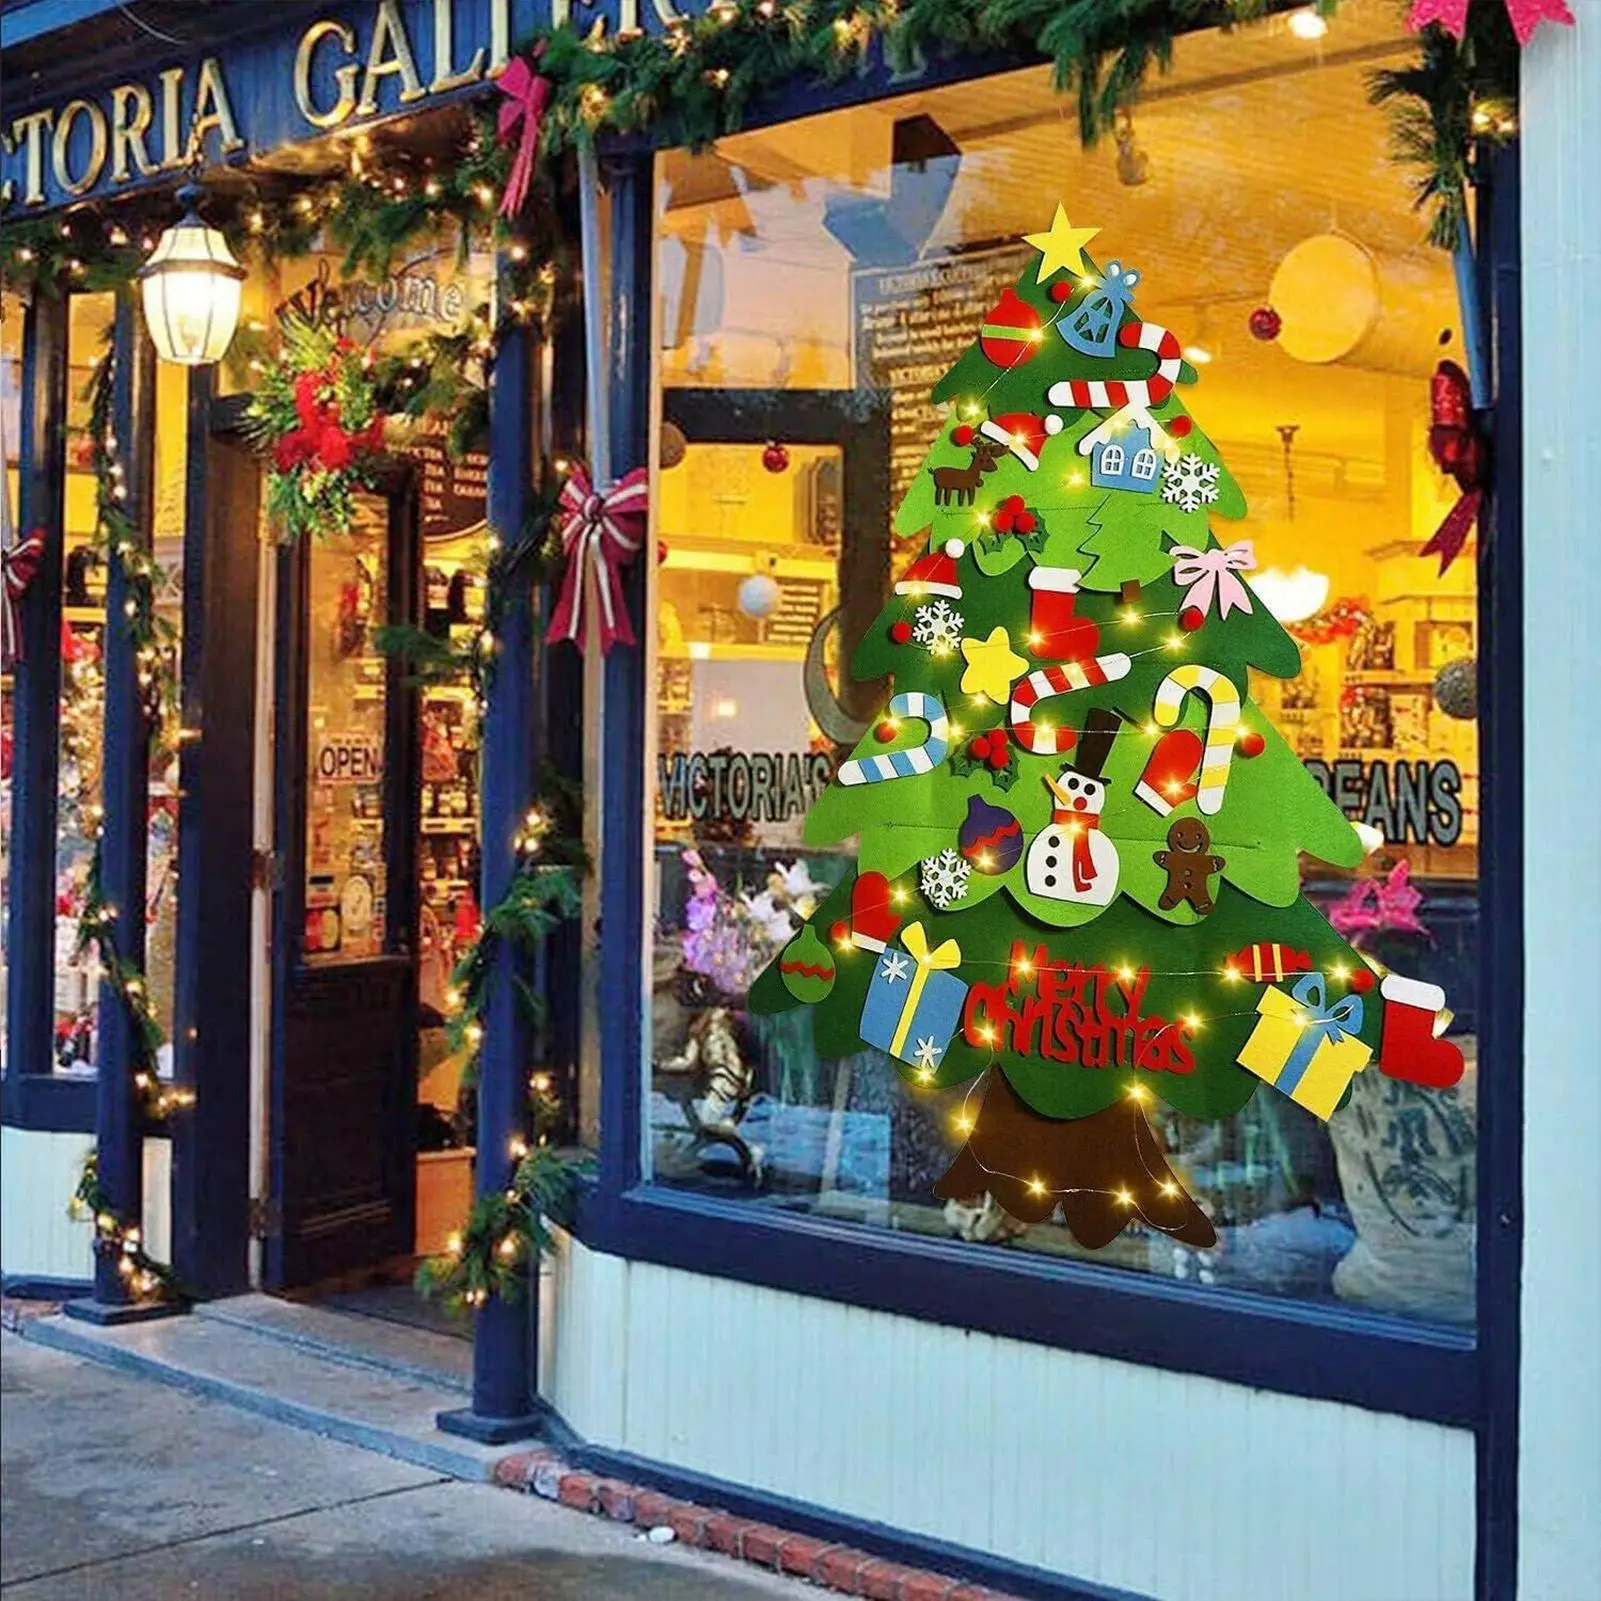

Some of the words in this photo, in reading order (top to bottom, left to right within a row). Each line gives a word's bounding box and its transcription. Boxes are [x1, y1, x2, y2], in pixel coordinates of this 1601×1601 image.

[1, 57, 245, 205] TORIA
[320, 746, 378, 777] OPEN
[1010, 939, 1150, 1019] Merry
[964, 982, 1196, 1076] Christmas
